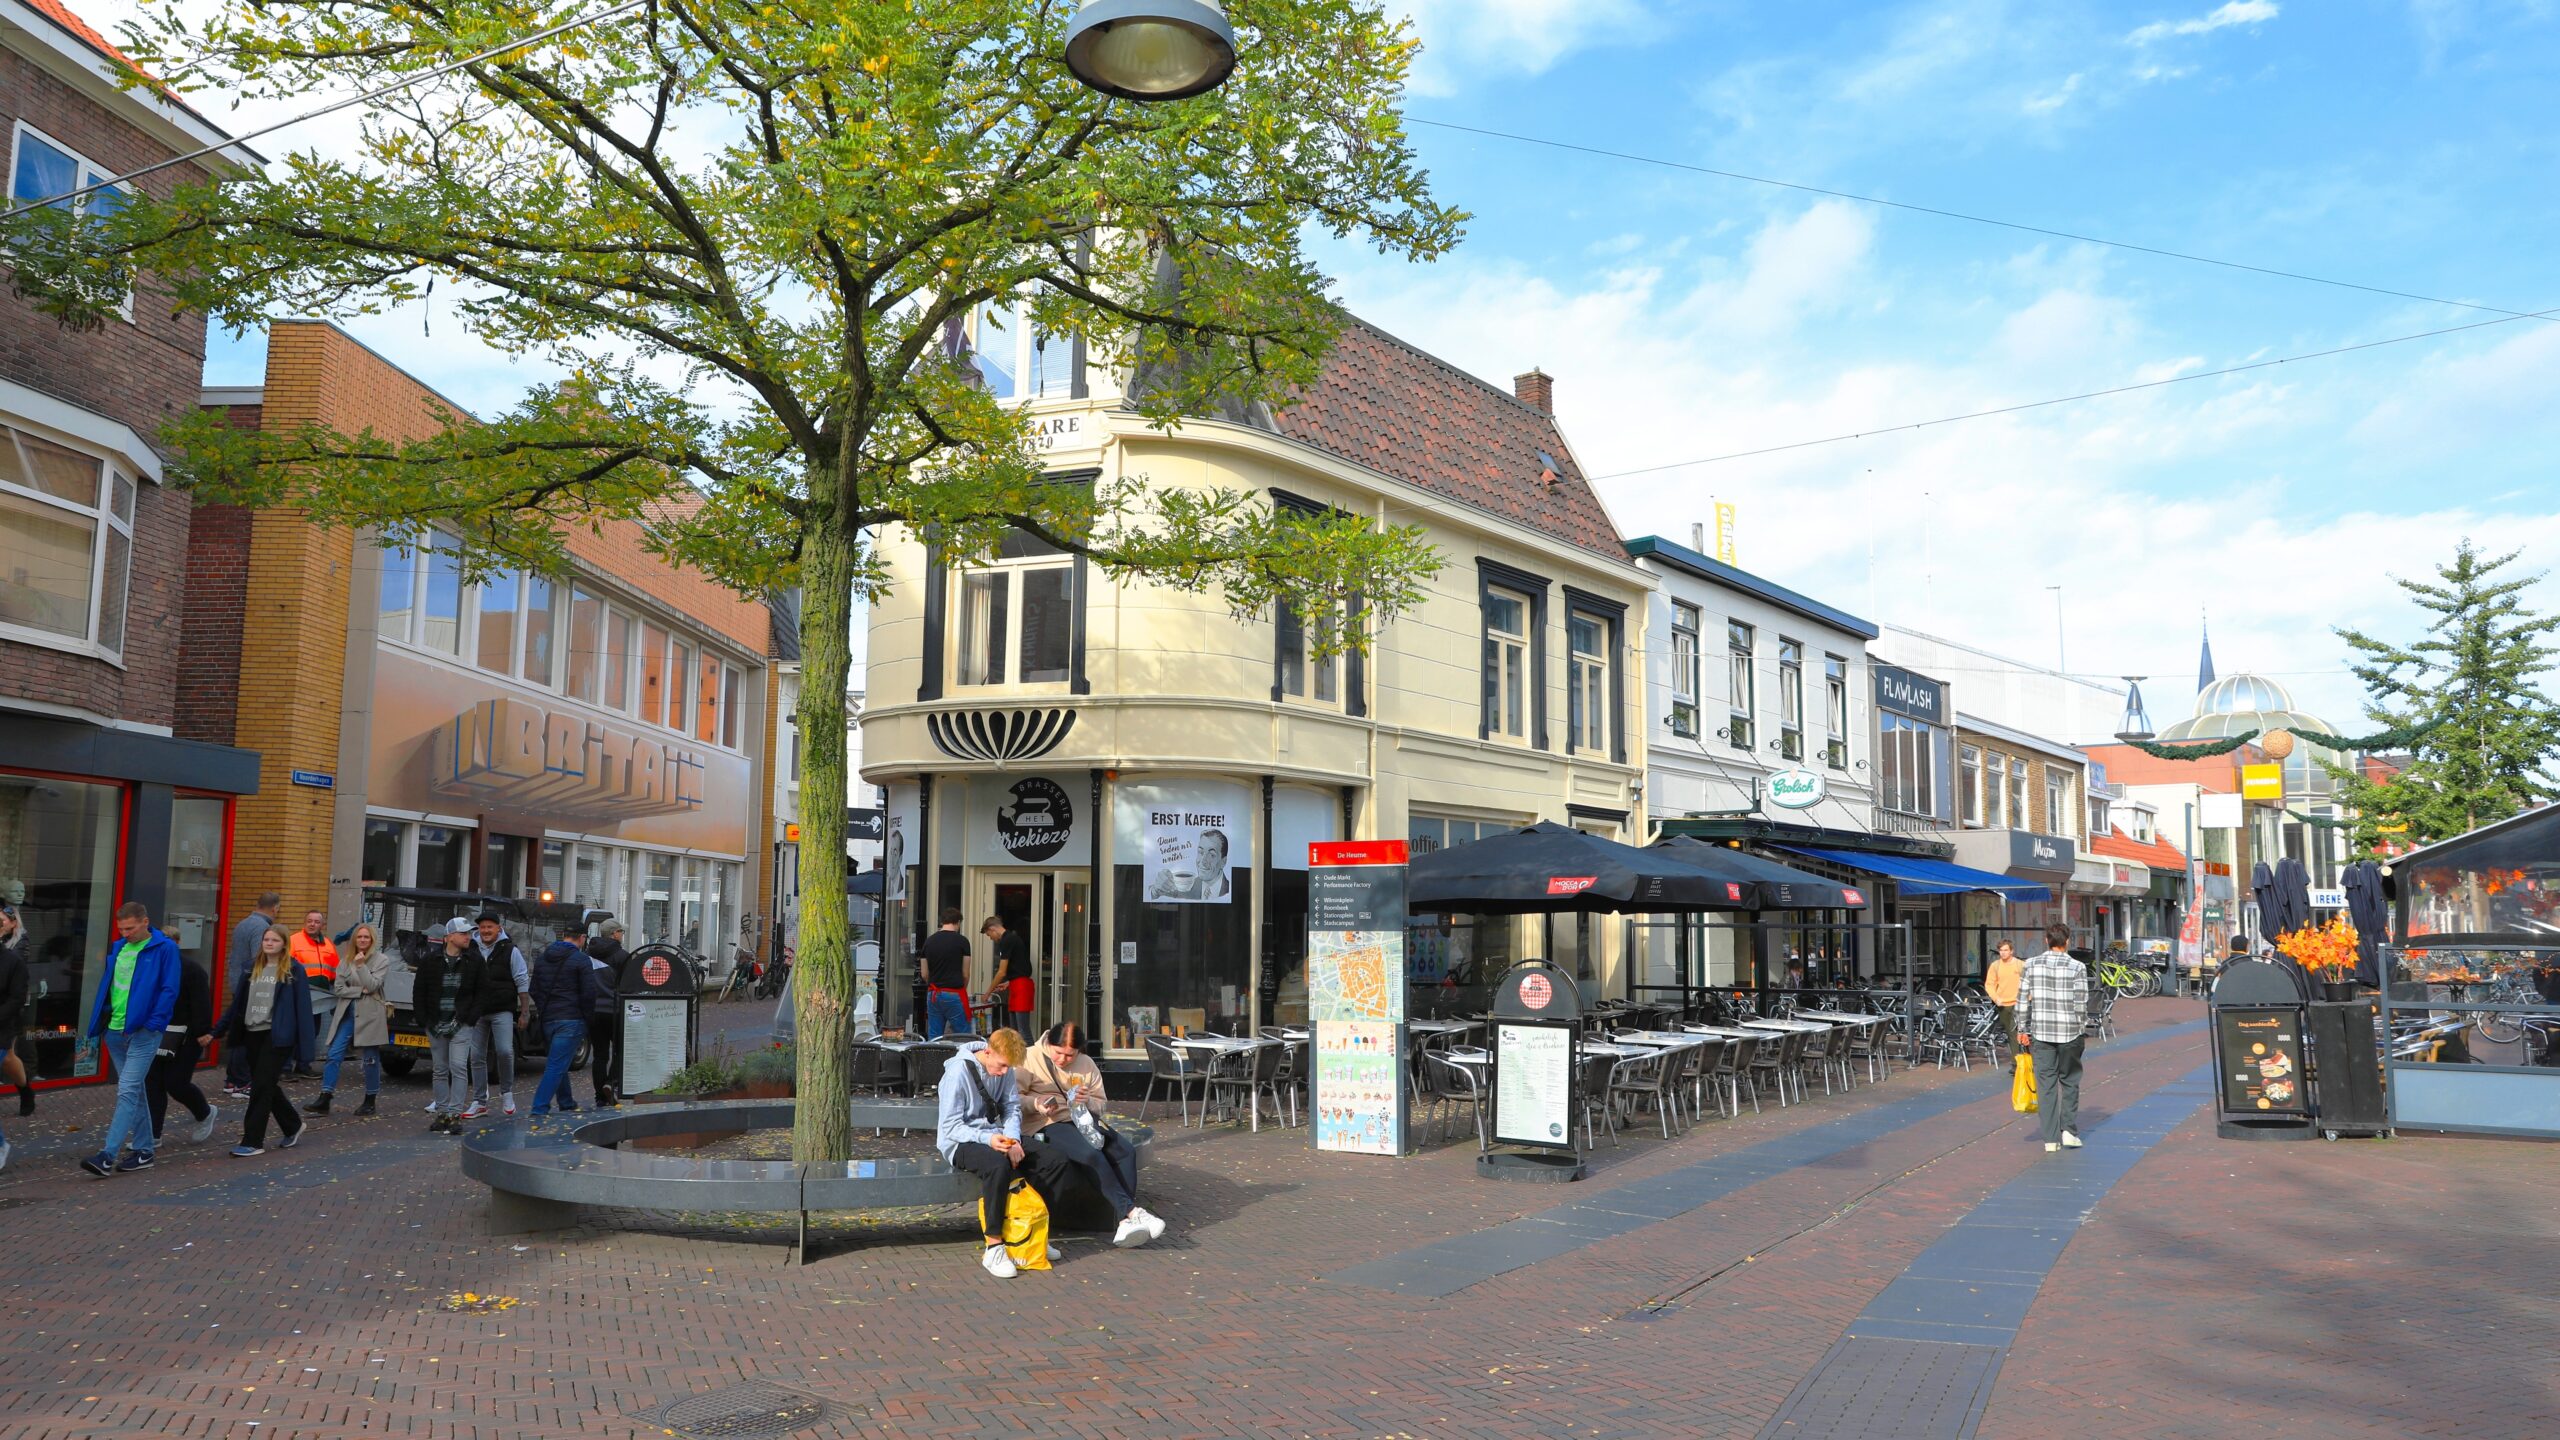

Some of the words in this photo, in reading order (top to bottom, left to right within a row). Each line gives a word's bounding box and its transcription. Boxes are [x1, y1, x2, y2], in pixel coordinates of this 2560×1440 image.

[1883, 675, 1932, 711] FLAWLASH
[1772, 777, 1815, 796] Grolsch
[1018, 780, 1070, 820] BRASSERIE
[1025, 815, 1046, 823] HET
[1151, 812, 1181, 826] ERST
[1184, 813, 1225, 828] KAFFEE!
[1408, 834, 1439, 854] offie
[2315, 894, 2342, 904] IRENE
